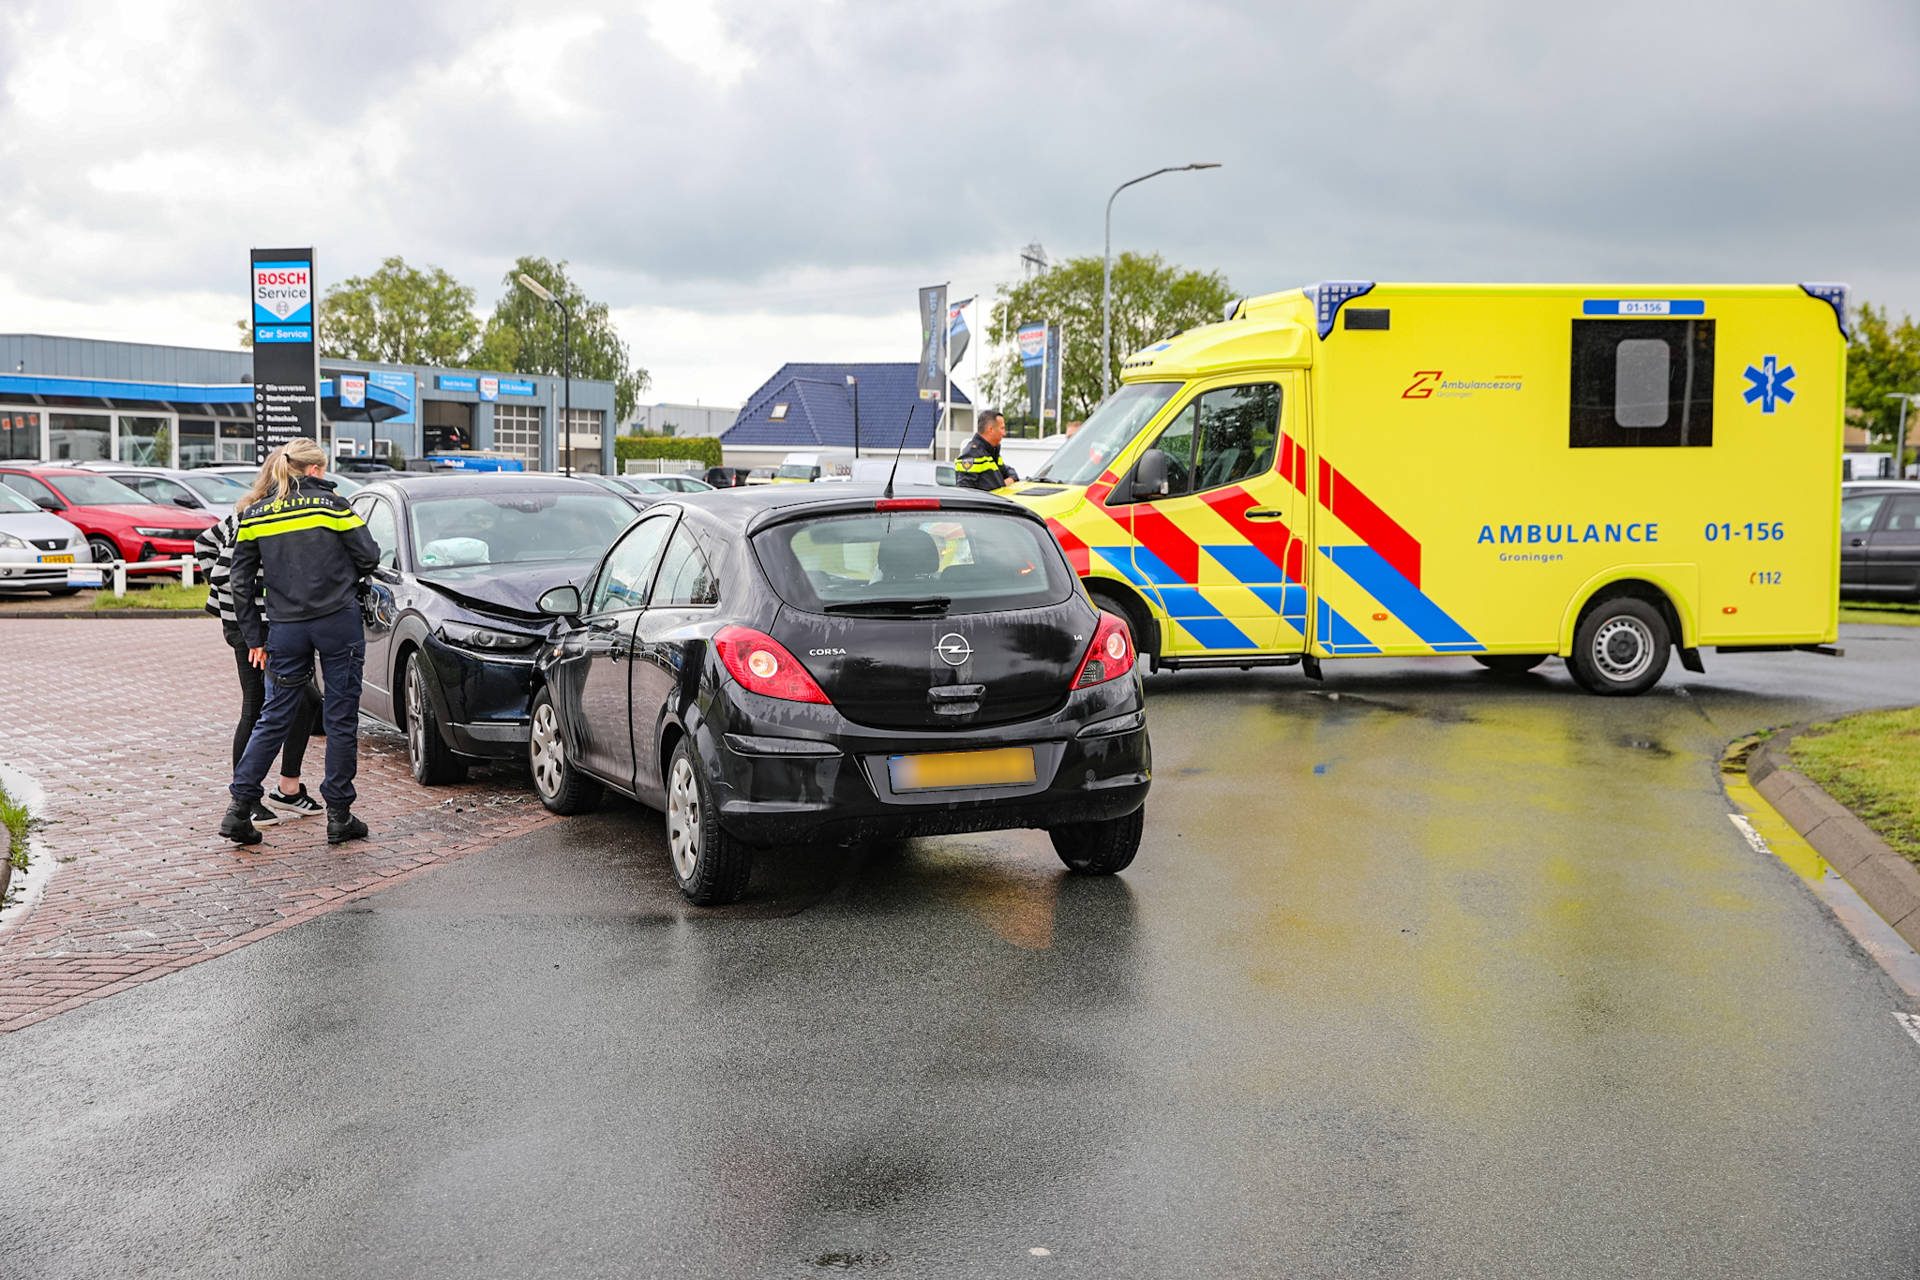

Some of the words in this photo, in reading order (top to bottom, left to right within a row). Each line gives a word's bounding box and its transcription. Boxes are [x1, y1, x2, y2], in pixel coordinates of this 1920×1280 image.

[257, 272, 307, 285] BOSCH
[257, 286, 307, 299] Service
[1626, 303, 1662, 312] 01-156
[258, 329, 274, 339] Car
[277, 329, 308, 339] Service
[1441, 380, 1522, 391] Ambulancezorg
[263, 497, 320, 513] POLITIE
[1477, 523, 1659, 544] AMBULANCE
[1705, 522, 1784, 541] 01-156
[1499, 553, 1564, 563] Groningen
[1759, 571, 1781, 584] 112
[809, 648, 847, 656] CORSA
